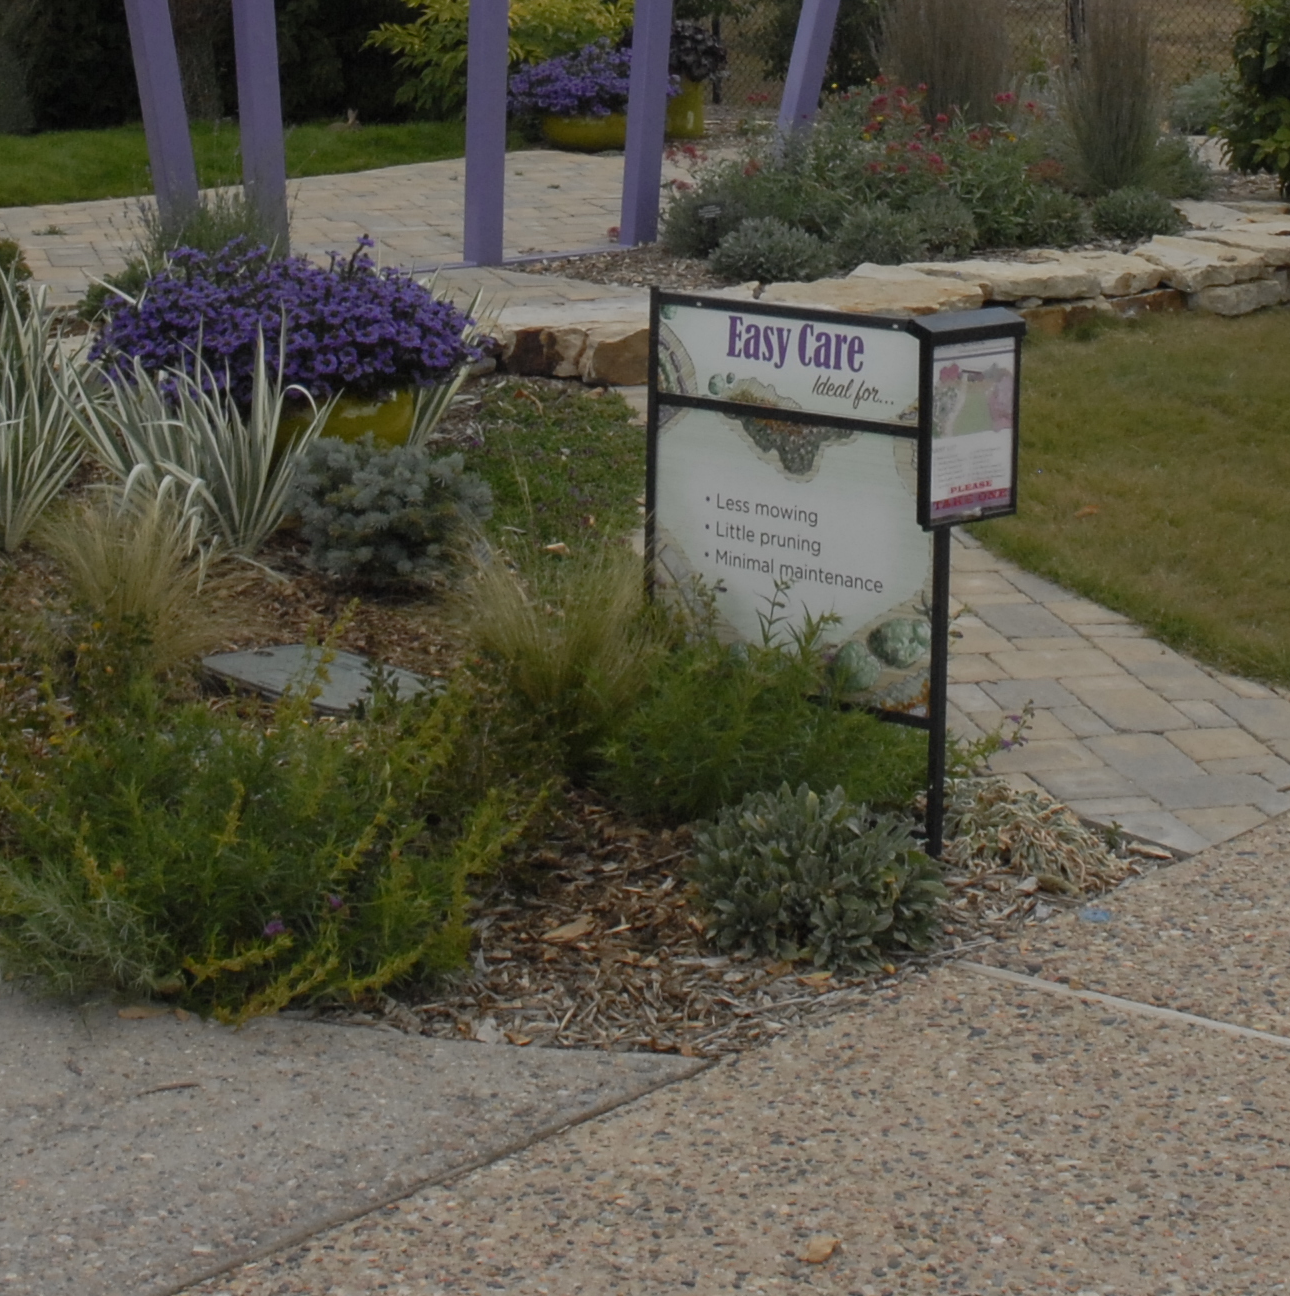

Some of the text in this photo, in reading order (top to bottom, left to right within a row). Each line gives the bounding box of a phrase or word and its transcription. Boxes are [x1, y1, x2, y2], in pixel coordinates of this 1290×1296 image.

[727, 315, 864, 372] Easy Care
[812, 375, 854, 399] Ideal
[934, 489, 1008, 510] TAKE ONE
[951, 481, 992, 494] PLEASE
[716, 493, 818, 527] Less mowing
[716, 521, 821, 556] Little pruning
[715, 549, 883, 593] Minimal maintenance
